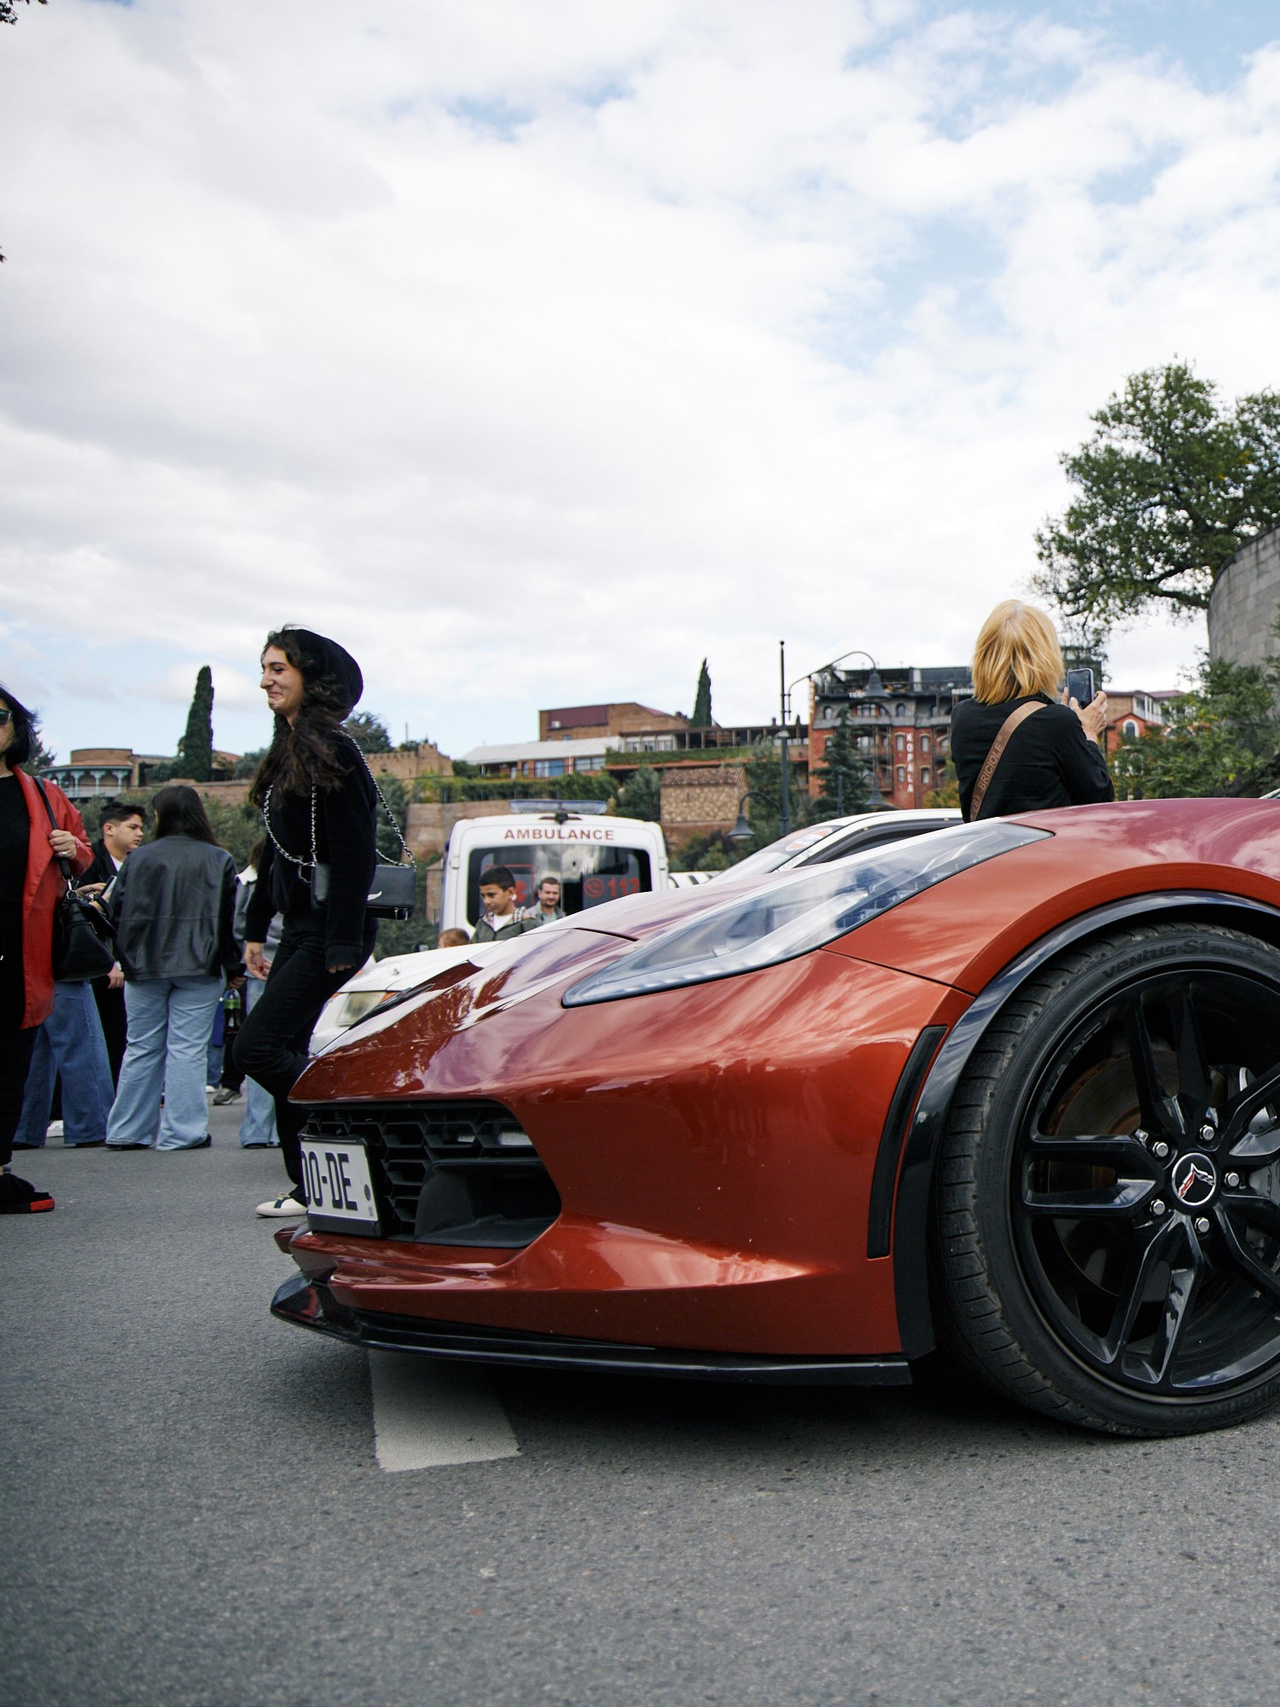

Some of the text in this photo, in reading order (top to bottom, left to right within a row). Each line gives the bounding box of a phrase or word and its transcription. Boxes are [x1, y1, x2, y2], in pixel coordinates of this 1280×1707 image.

[906, 732, 914, 793] KOPALA
[978, 742, 1003, 792] BRICIOLE
[504, 828, 615, 841] AMBULANCE
[608, 876, 640, 898] 112
